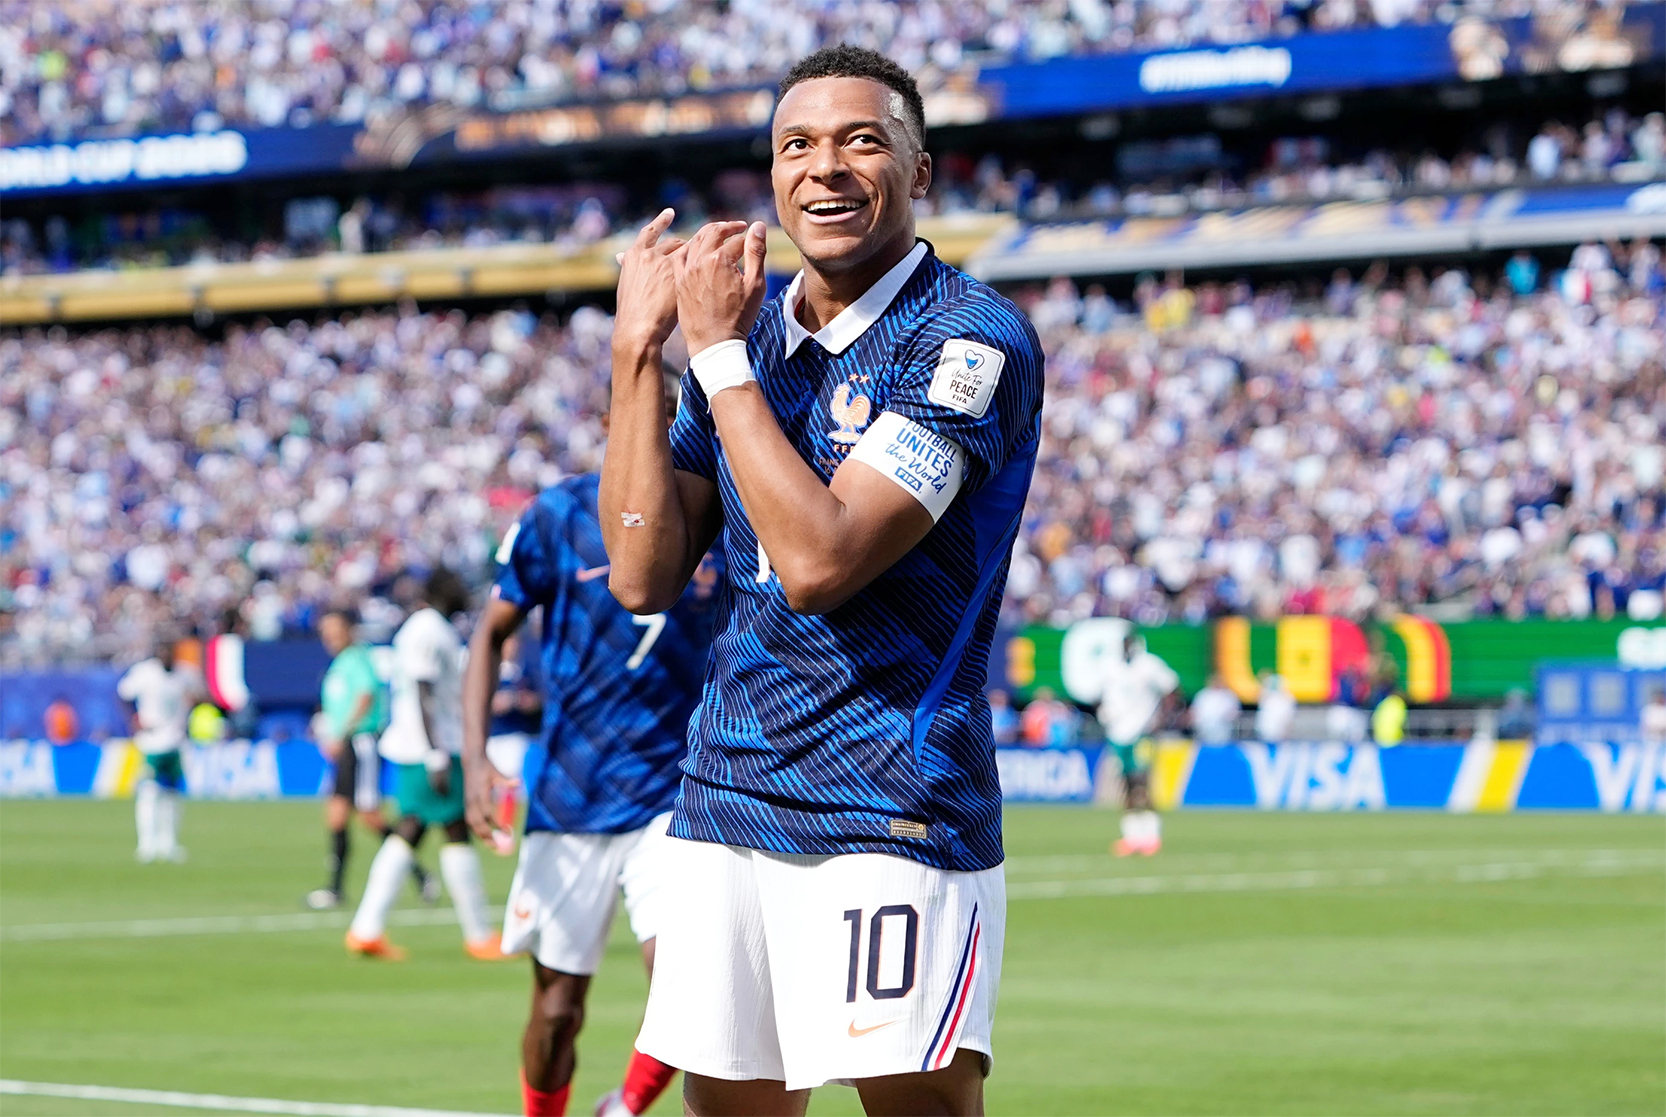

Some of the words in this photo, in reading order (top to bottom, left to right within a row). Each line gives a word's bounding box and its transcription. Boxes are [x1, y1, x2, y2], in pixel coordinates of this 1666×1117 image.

[949, 379, 978, 399] PEACE
[951, 368, 971, 382] Unite
[952, 394, 968, 404] FIFA
[896, 428, 952, 477] UNITES
[905, 420, 957, 463] FOOTBALL
[885, 442, 907, 462] the
[908, 457, 947, 494] World
[896, 467, 923, 491] FIFA
[626, 612, 667, 670] 7
[1244, 741, 1387, 811] VISA
[843, 904, 919, 1003] 10
